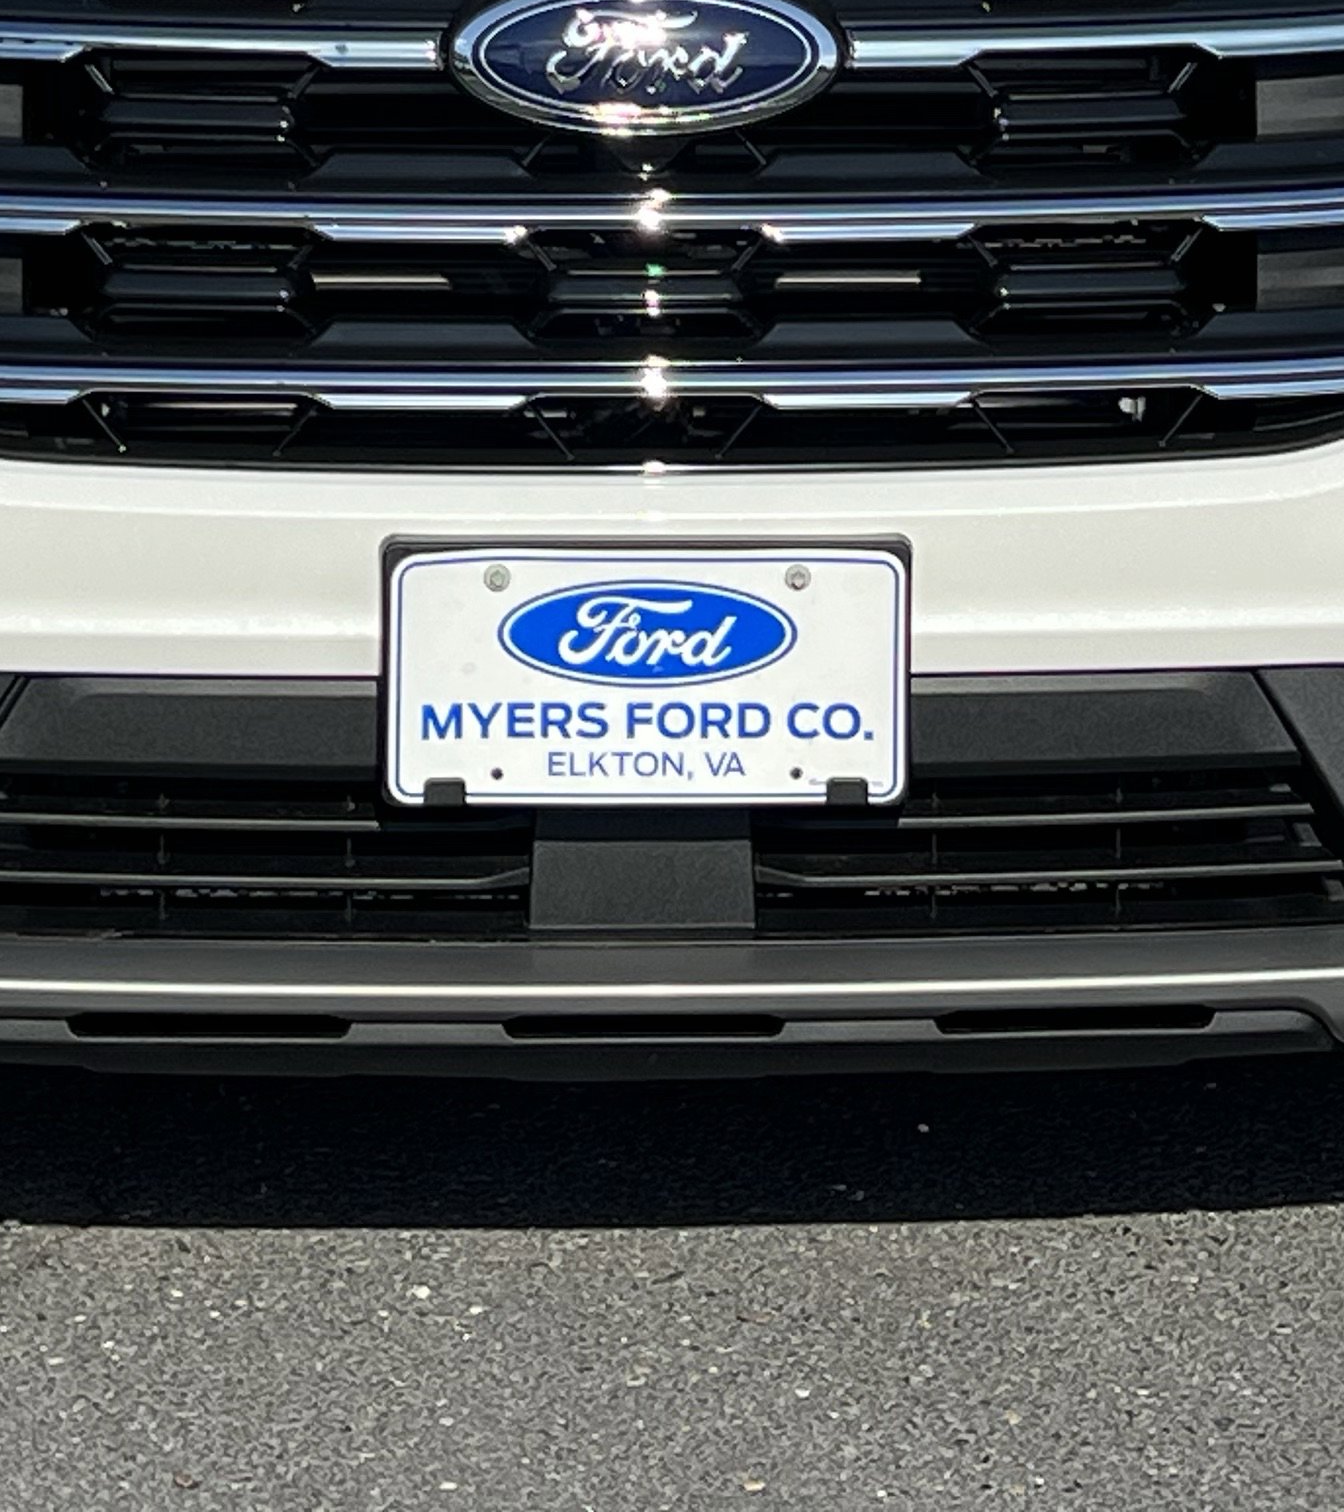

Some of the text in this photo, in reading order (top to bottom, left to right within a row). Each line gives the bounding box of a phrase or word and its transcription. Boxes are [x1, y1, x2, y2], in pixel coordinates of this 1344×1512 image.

[545, 8, 750, 94] Ford
[558, 594, 738, 667] Ford
[420, 701, 875, 741] MYERS FORD CO.
[547, 750, 747, 781] ELKTON, VA
